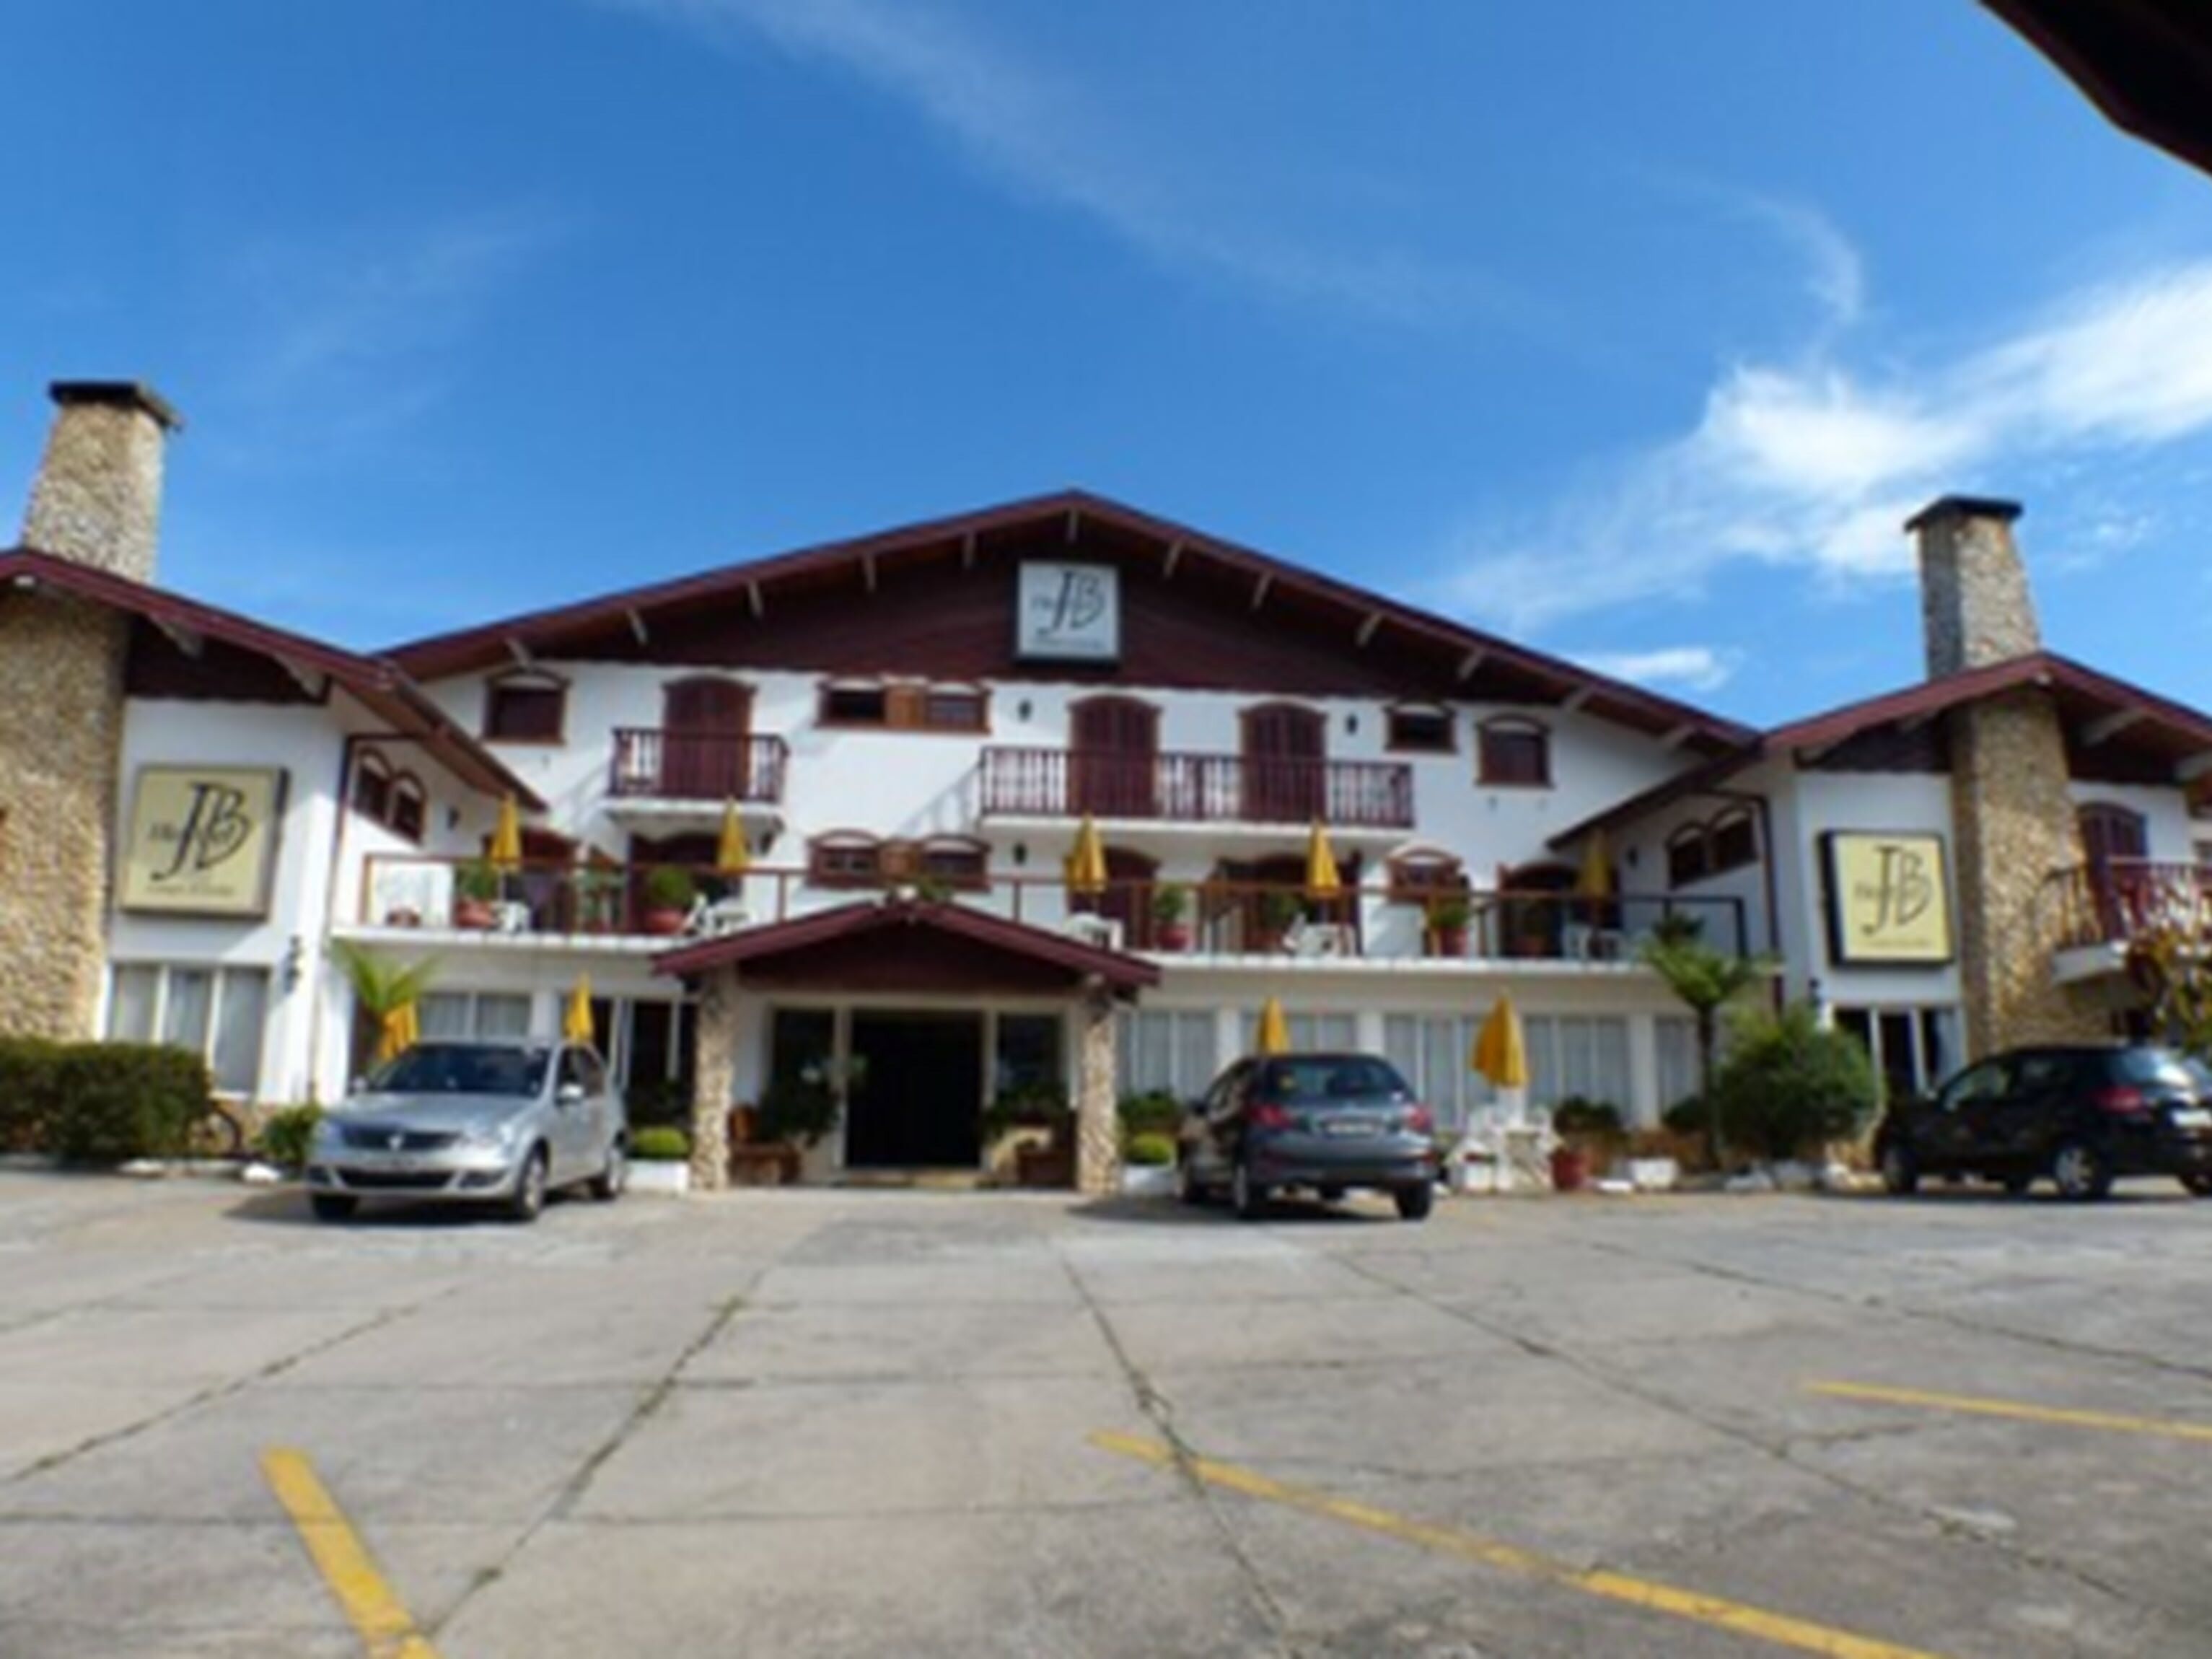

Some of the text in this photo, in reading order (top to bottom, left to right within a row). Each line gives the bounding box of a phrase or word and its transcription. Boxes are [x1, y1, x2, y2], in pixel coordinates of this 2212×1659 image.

[1036, 569, 1106, 637] JB
[150, 781, 253, 881] JB
[1861, 846, 1934, 936] JB
